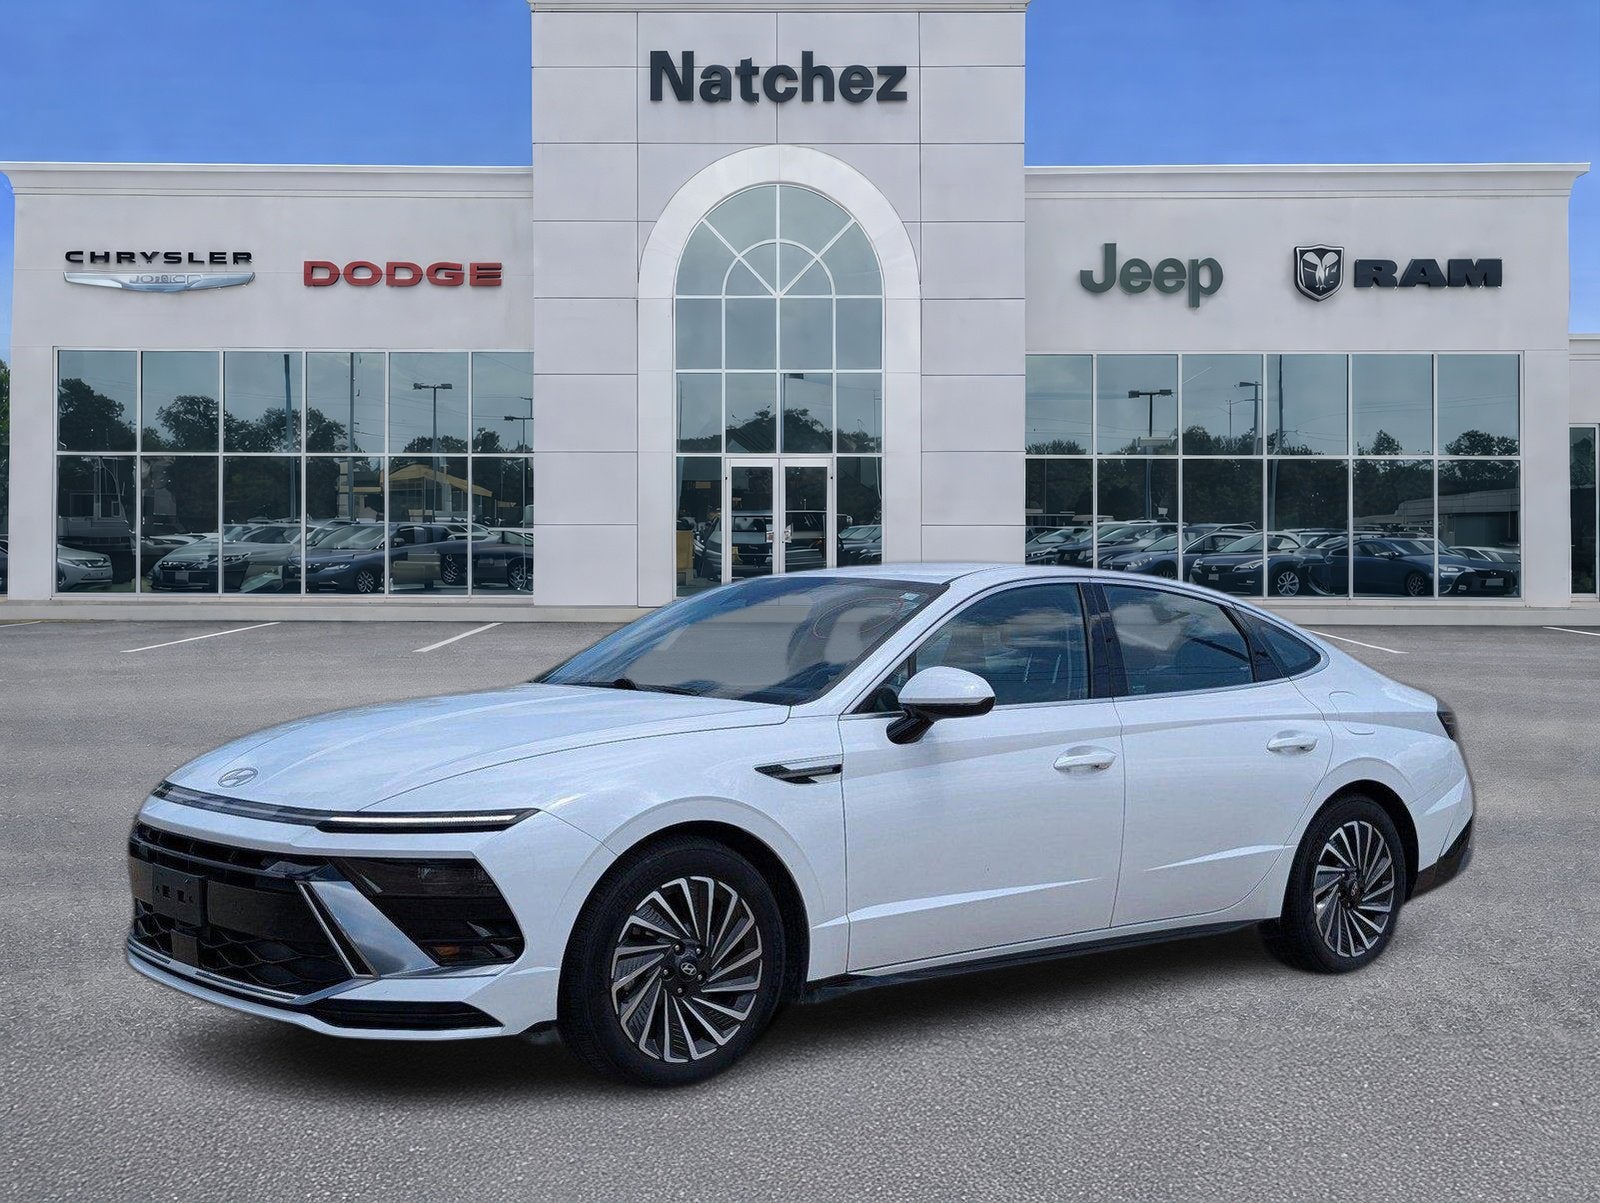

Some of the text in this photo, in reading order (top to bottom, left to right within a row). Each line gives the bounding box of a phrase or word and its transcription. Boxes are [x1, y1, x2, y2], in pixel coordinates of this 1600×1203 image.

[650, 50, 908, 103] Natchez
[65, 250, 253, 265] CHRYSLER
[304, 260, 502, 287] DODGE
[1080, 242, 1224, 308] Jeep
[1354, 258, 1503, 288] RAM
